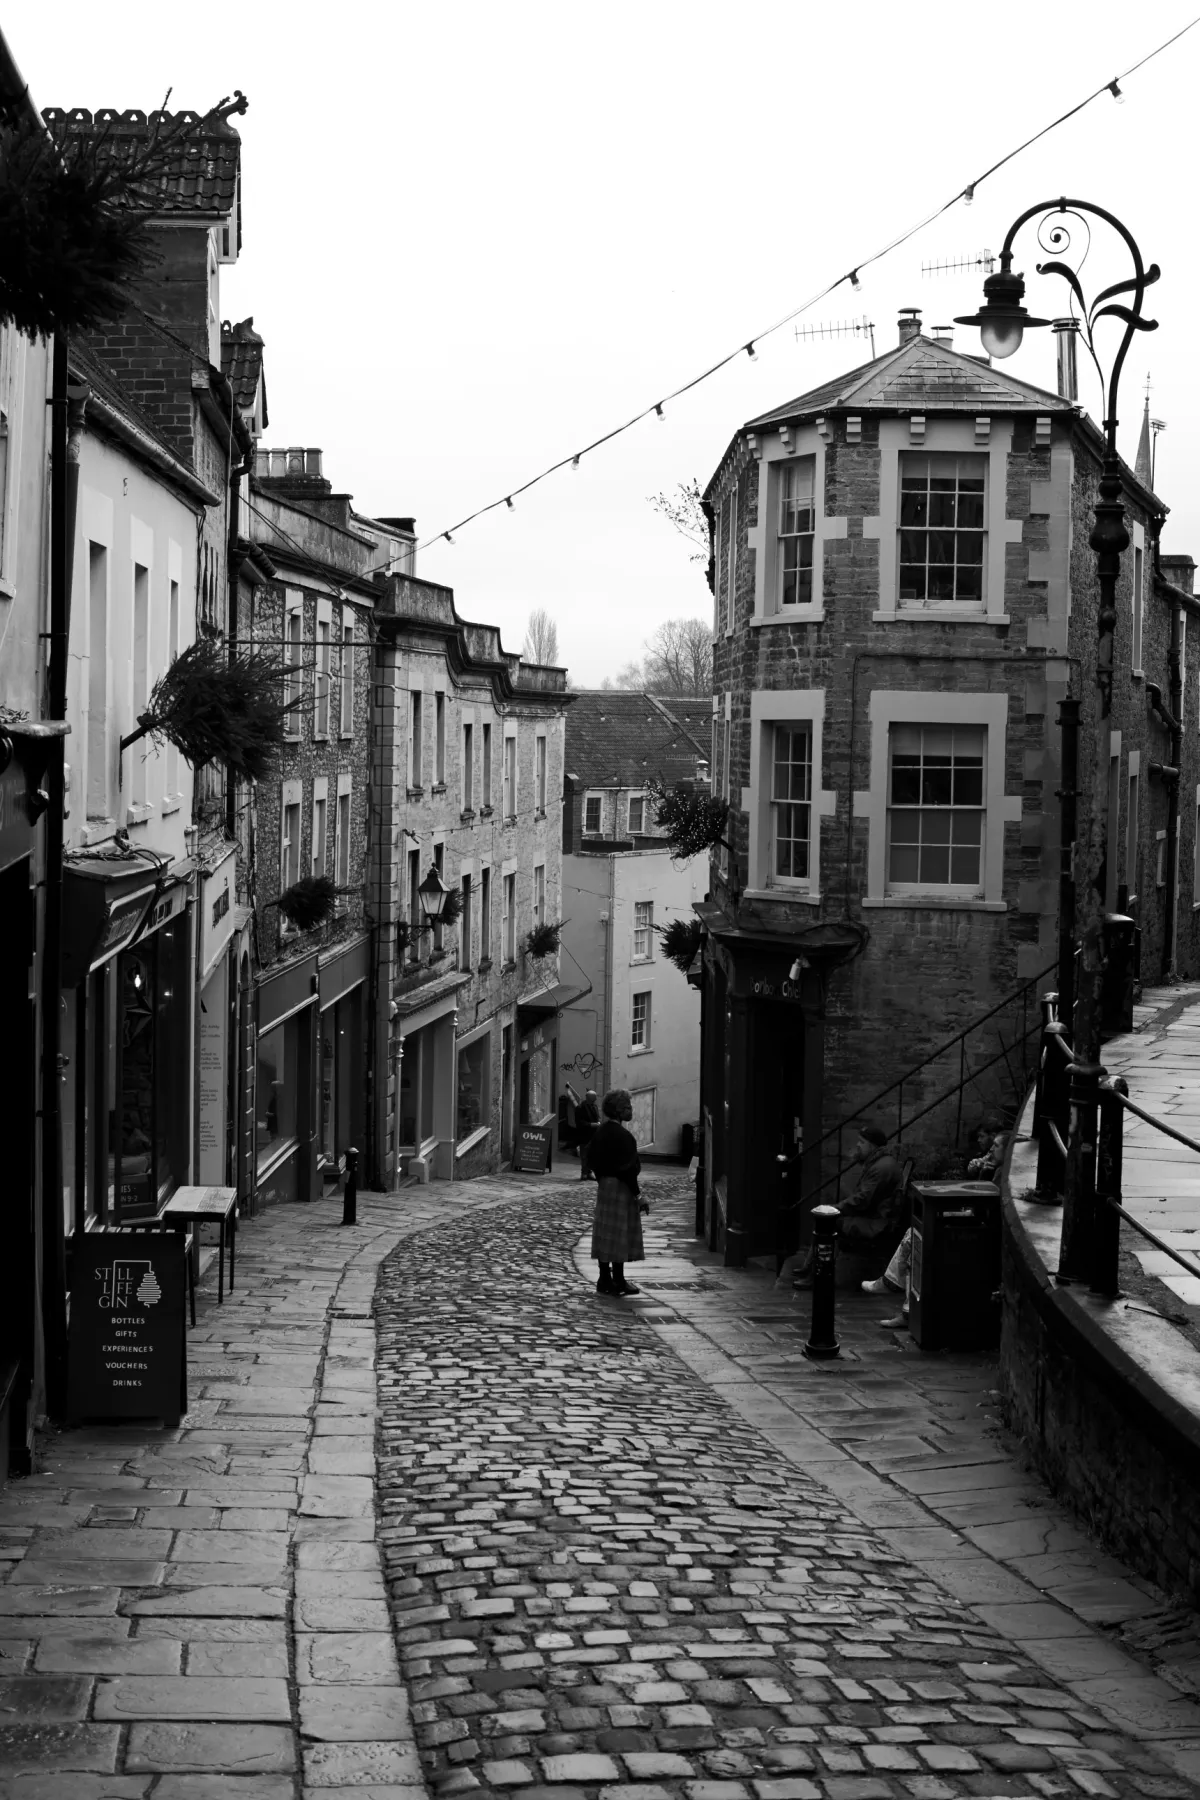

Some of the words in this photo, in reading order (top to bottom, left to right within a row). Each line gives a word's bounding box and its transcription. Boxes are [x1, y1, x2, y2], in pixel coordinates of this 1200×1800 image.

[522, 1131, 546, 1141] OWL
[95, 1267, 134, 1280] STILL
[103, 1282, 132, 1294] LIFE
[98, 1295, 128, 1308] GIN
[111, 1317, 146, 1325] BOTTLES
[115, 1330, 138, 1338] GIFTS
[102, 1345, 154, 1353] EXPERIENCES
[105, 1362, 148, 1370] VOUCHERS
[112, 1379, 142, 1387] DRINKS
